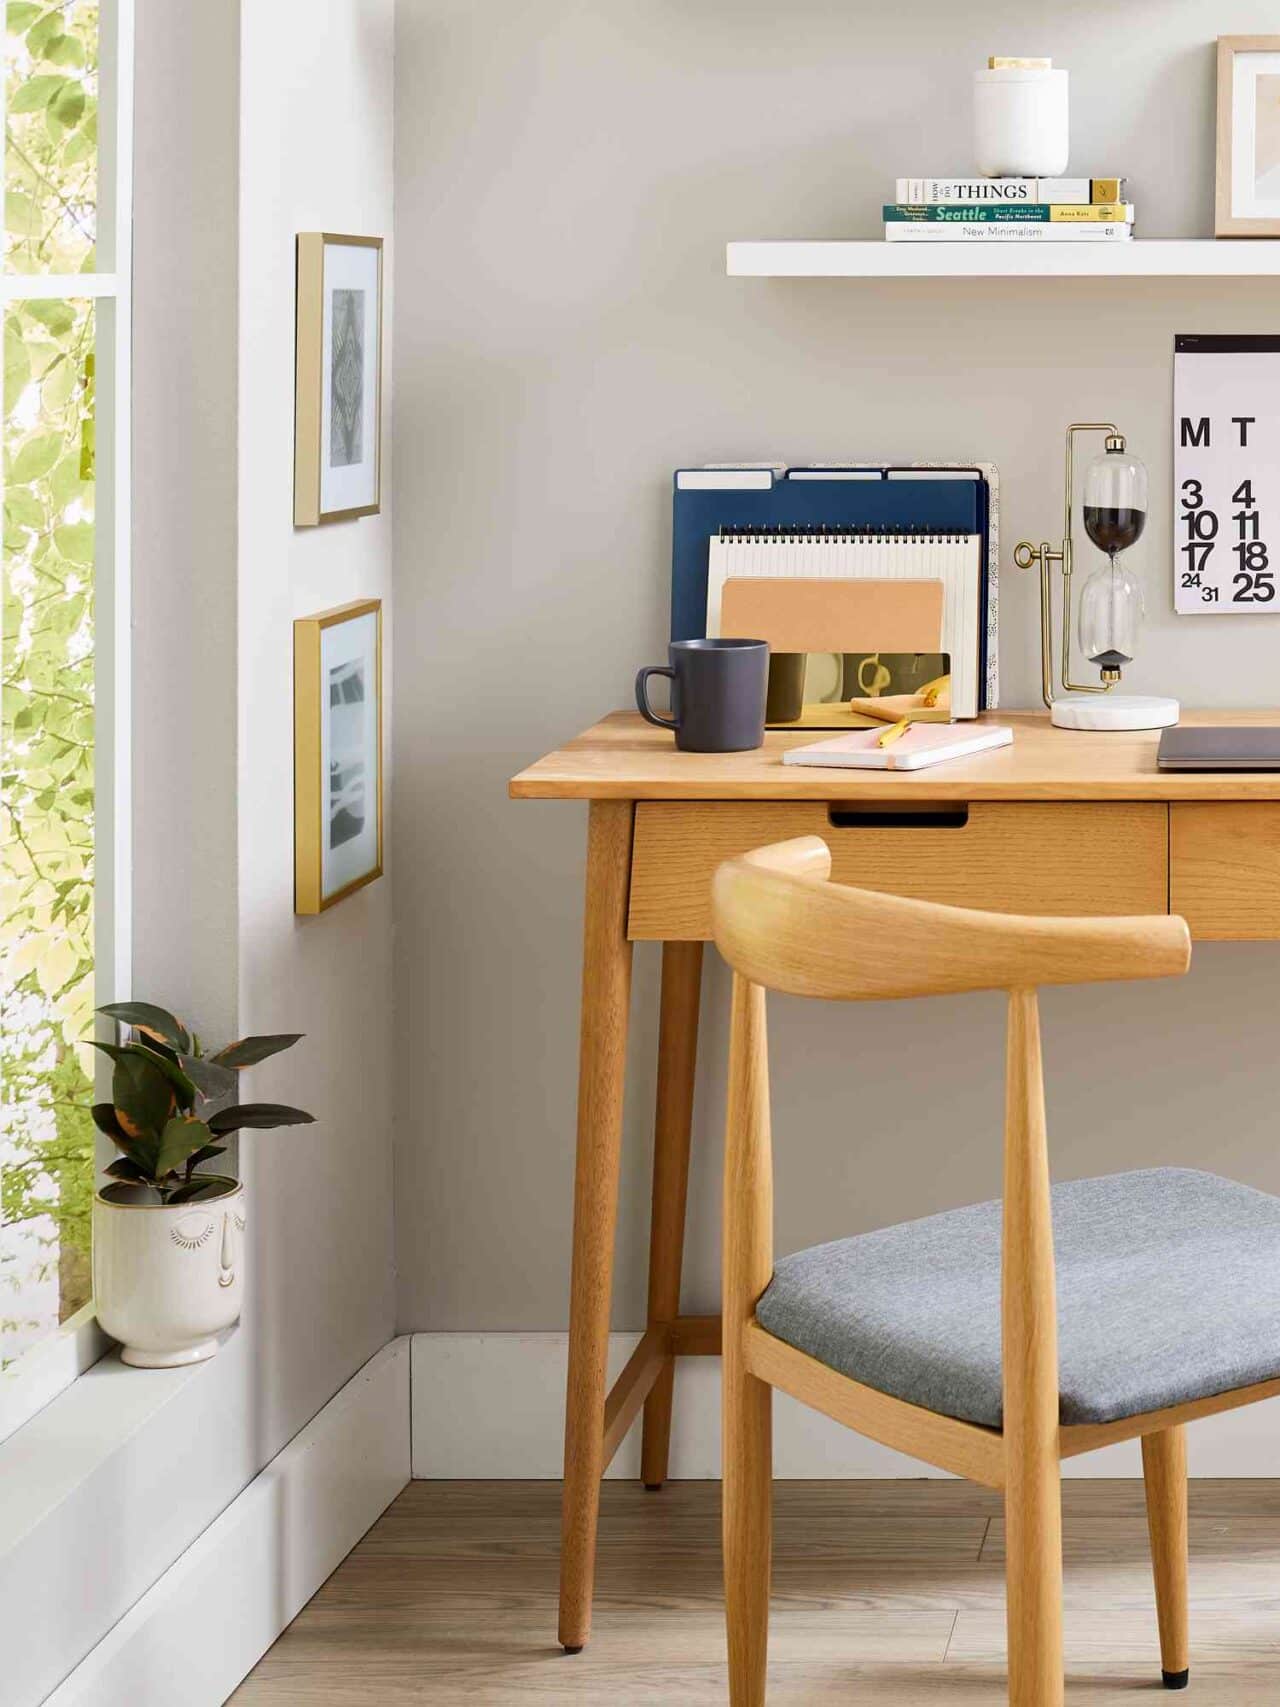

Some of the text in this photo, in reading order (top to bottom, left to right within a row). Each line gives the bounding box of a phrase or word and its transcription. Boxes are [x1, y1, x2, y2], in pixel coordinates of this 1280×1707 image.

[954, 184, 1027, 199] THINGS
[936, 206, 987, 221] Seattle
[962, 226, 1042, 237] New Minimalism
[1181, 417, 1210, 447] M
[1232, 417, 1255, 446] T
[1181, 480, 1203, 509] 3
[1232, 480, 1255, 508] 4
[1181, 510, 1218, 540] 10
[1232, 511, 1259, 540] 11
[1181, 542, 1214, 571] 17
[1232, 542, 1268, 571] 18
[1182, 573, 1202, 587] 24
[1202, 587, 1218, 601] 31
[1233, 573, 1275, 602] 25
